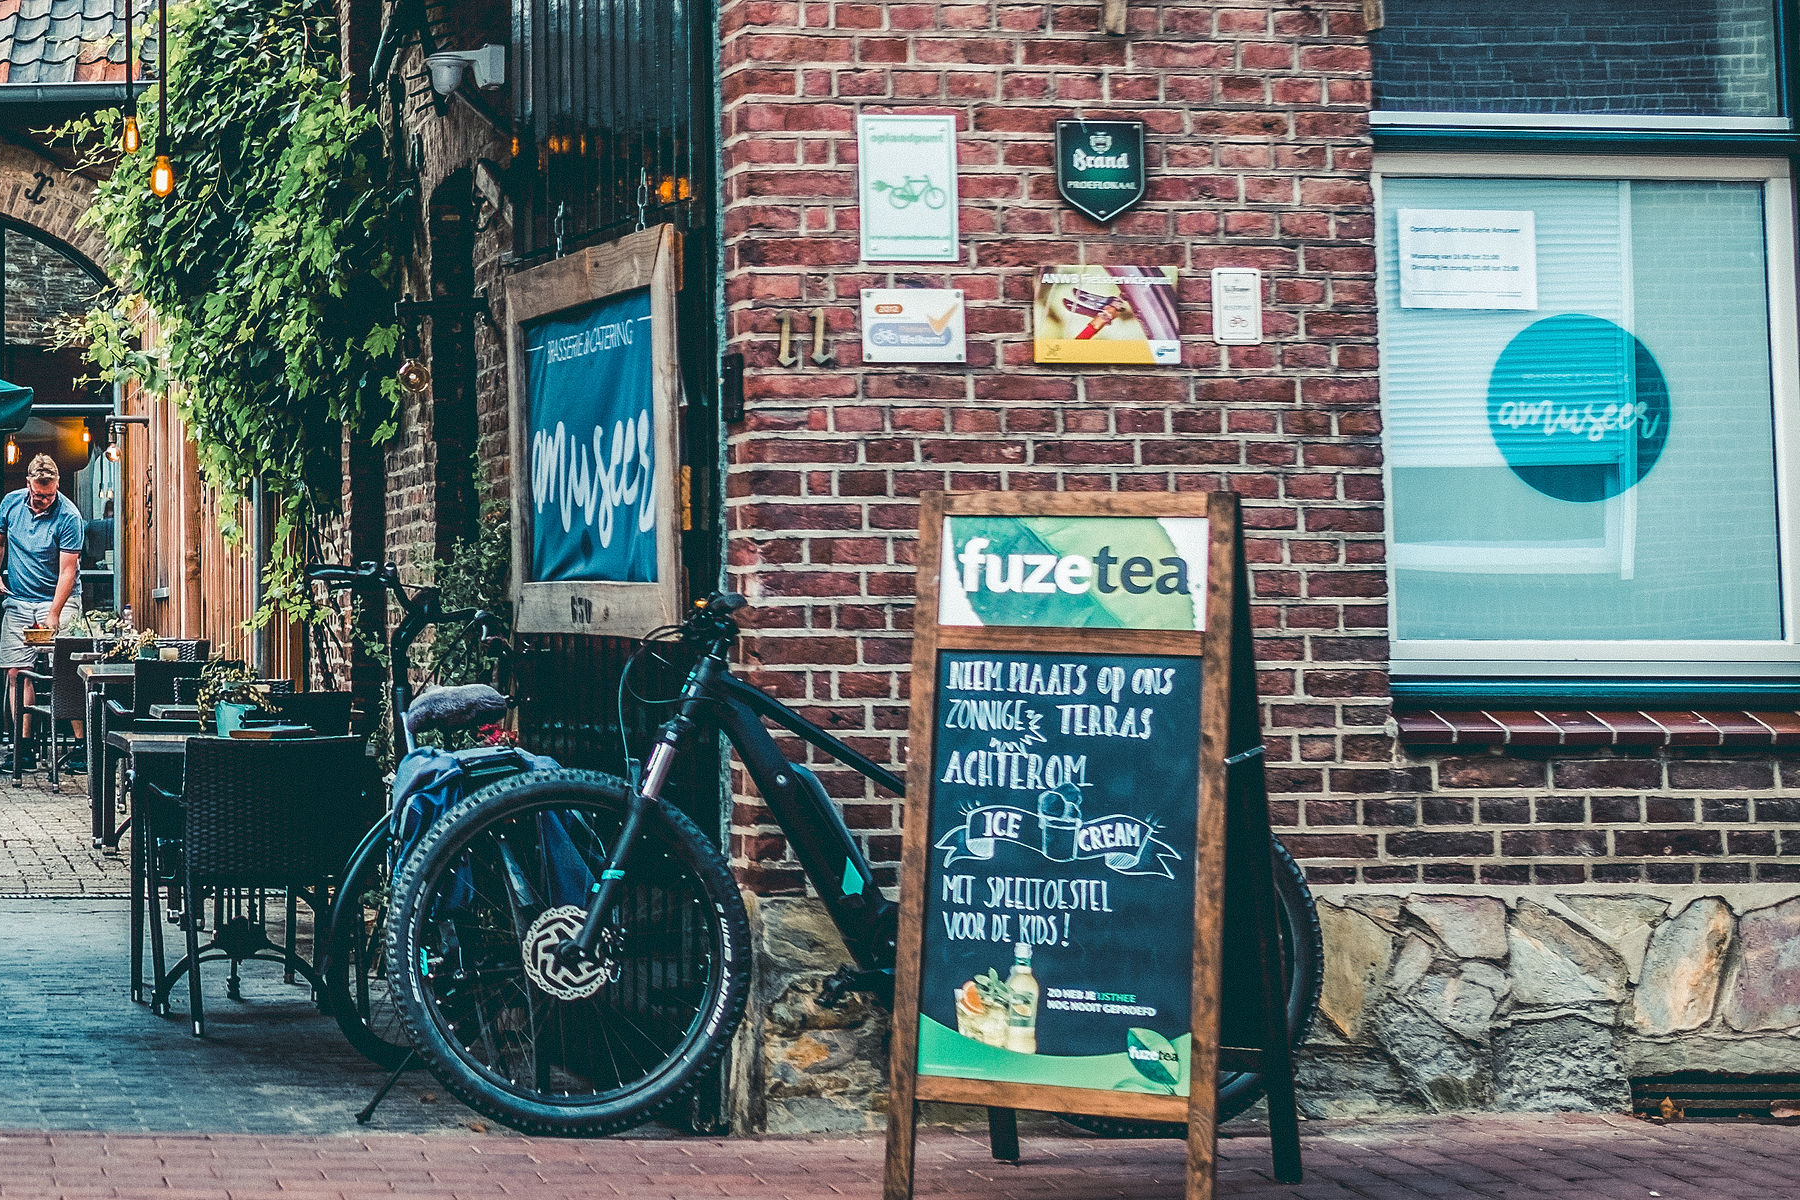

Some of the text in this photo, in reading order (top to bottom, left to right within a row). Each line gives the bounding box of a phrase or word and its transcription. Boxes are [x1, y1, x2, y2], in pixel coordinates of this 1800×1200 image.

[1072, 148, 1130, 171] Brand
[1498, 400, 1661, 442] amuseer
[945, 660, 1004, 692] NEEM
[1006, 661, 1088, 696] PLAATS
[1131, 666, 1177, 696] ONS
[945, 698, 1154, 740] ZONNIGE TERRAS
[940, 749, 1095, 791] ACHTEROM
[982, 810, 1141, 852] ICE CREAM
[942, 873, 1114, 913] MET SPEELTOESTEL
[942, 910, 986, 942] VOOR
[991, 911, 1012, 943] DE
[1046, 999, 1070, 1011] NOG
[1070, 1001, 1102, 1013] NOOIT
